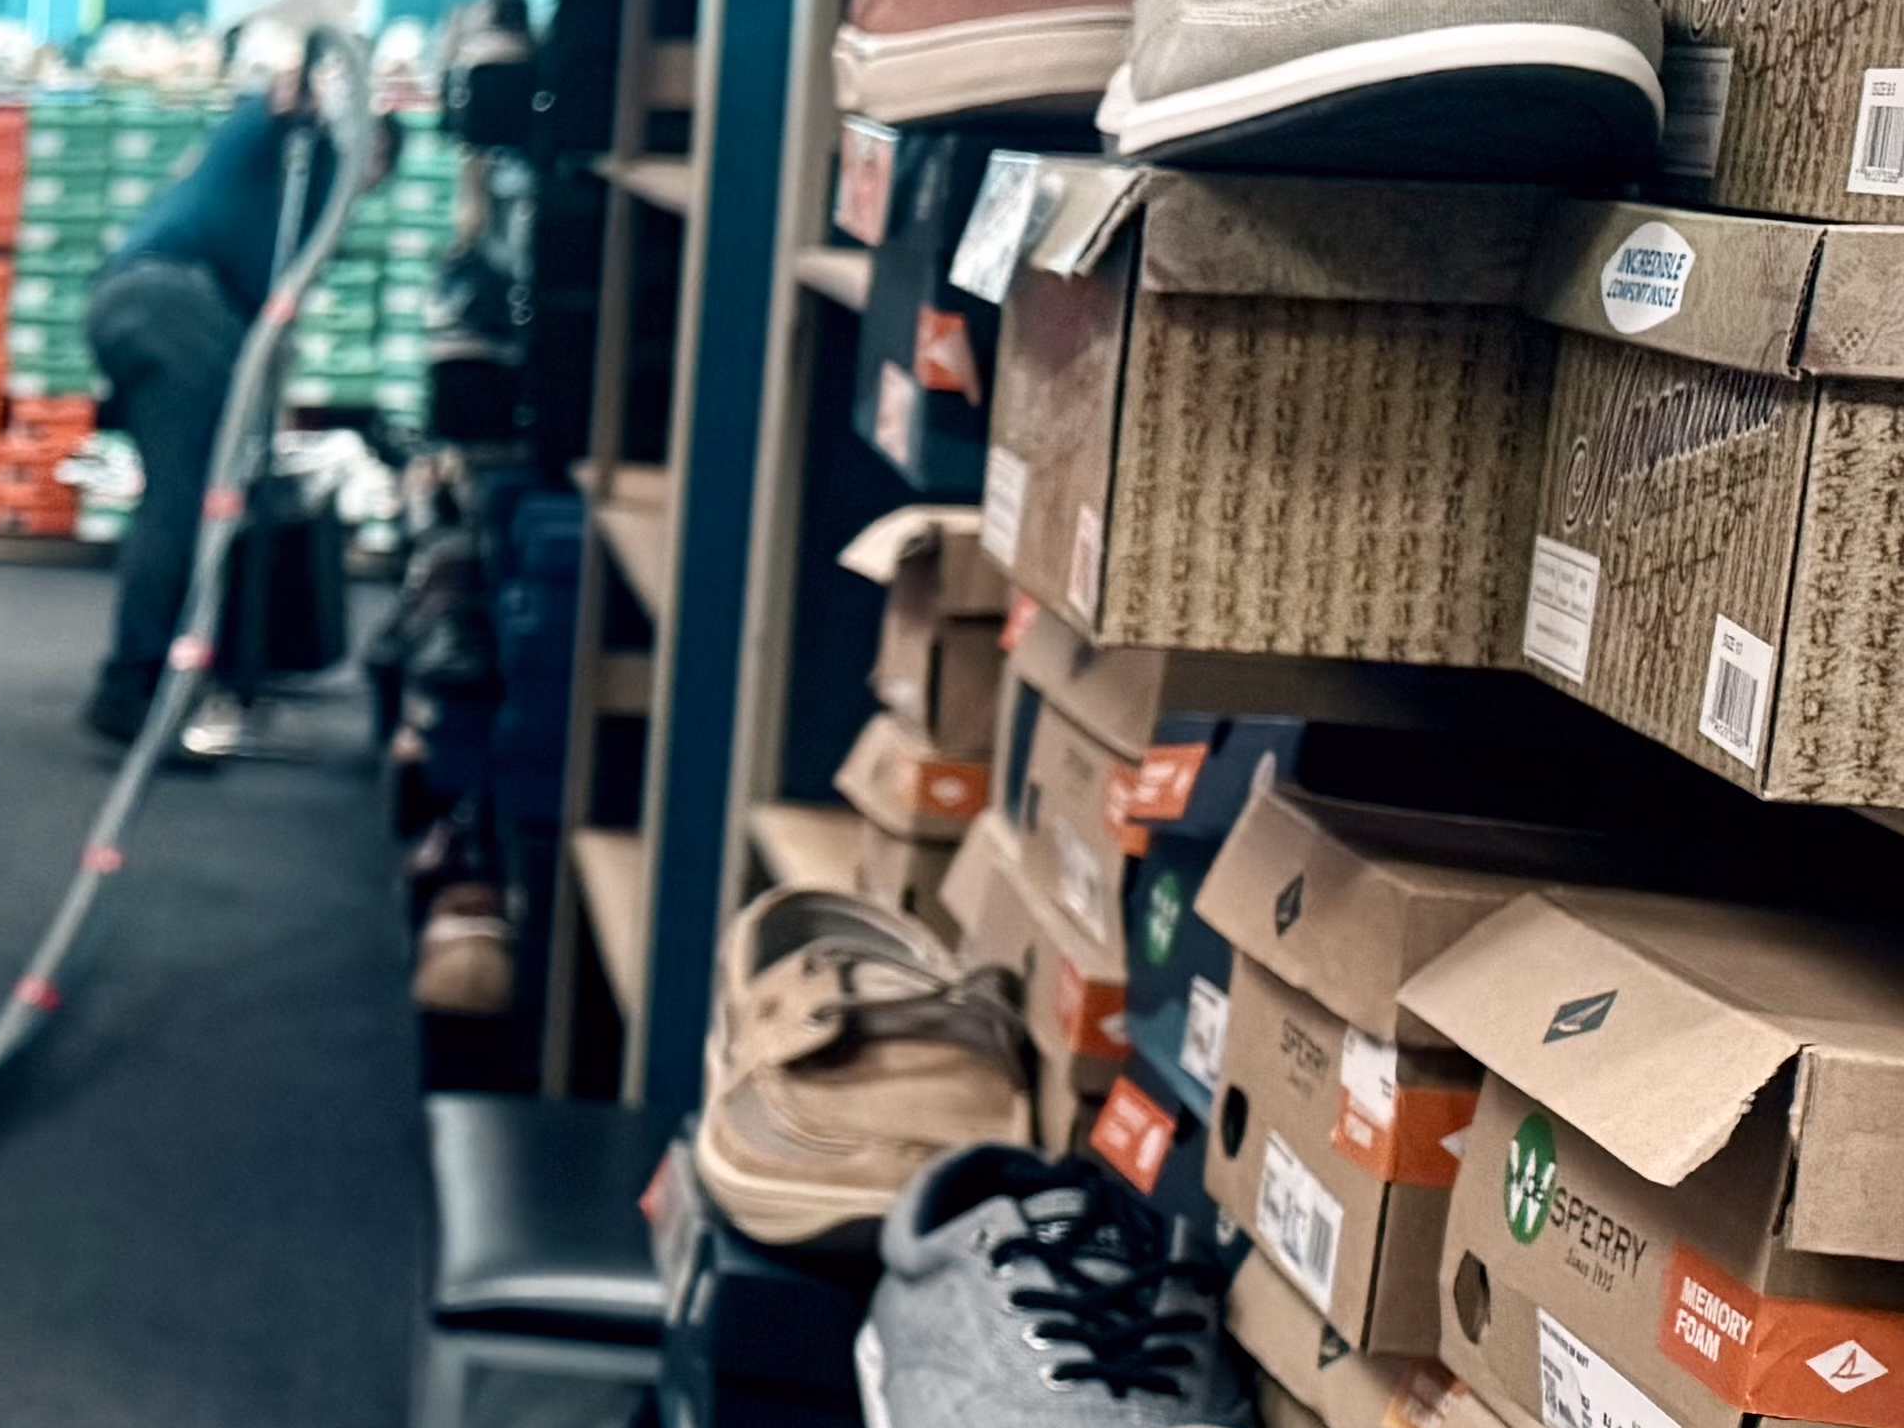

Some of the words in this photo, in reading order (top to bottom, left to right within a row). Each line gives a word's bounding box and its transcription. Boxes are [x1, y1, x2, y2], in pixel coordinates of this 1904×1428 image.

[1606, 278, 1648, 302] COMFORT
[1616, 248, 1688, 281] INCREDIBLE
[1549, 1186, 1648, 1281] SPERRY
[1674, 1308, 1723, 1363] FOAM
[1679, 1276, 1754, 1346] MEMORY
